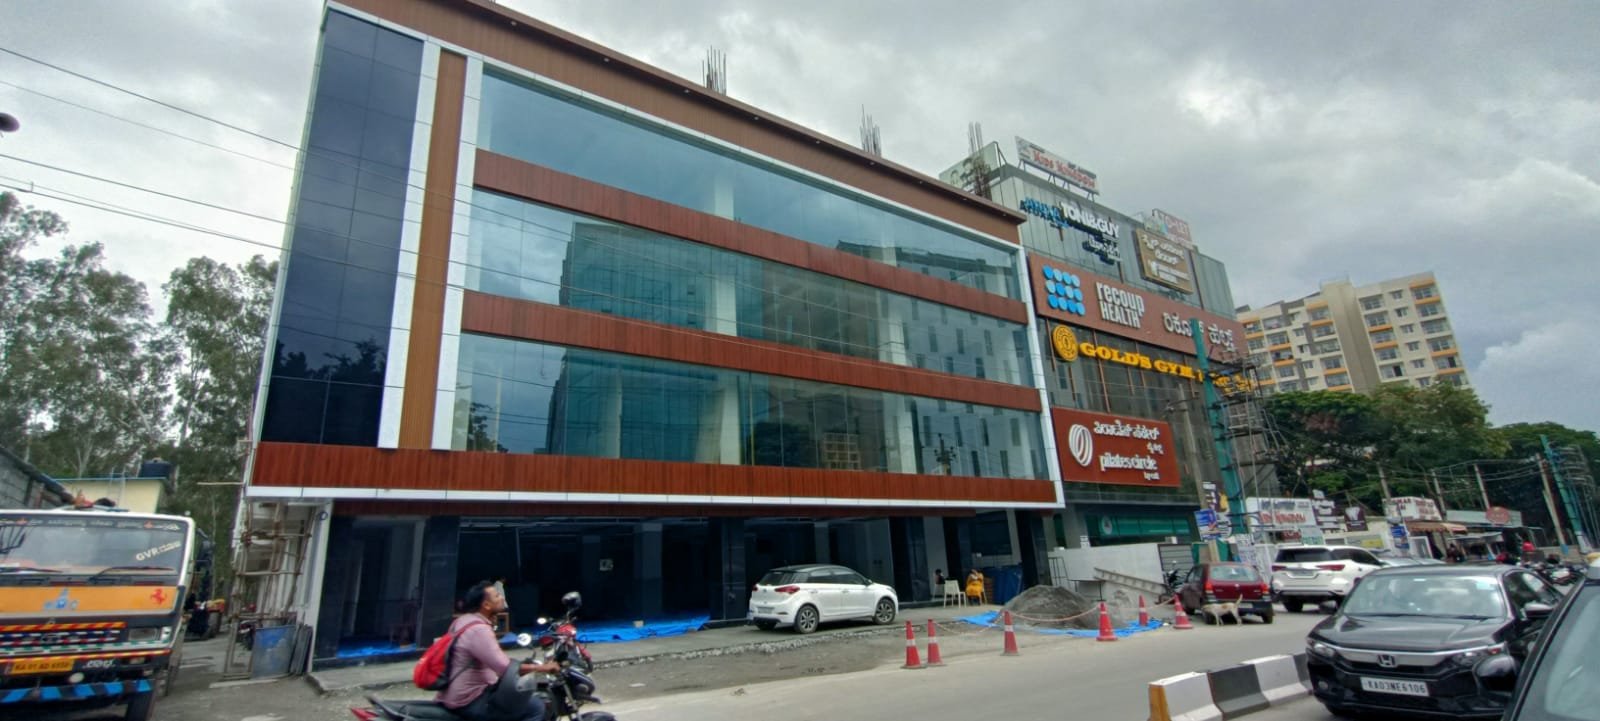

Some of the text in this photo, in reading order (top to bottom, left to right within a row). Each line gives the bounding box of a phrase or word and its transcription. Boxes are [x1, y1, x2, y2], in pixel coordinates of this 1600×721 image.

[1096, 280, 1145, 318] recoup
[1100, 301, 1141, 329] HEALTH
[1080, 341, 1152, 370] GOLD'S
[1153, 358, 1196, 379] GYM
